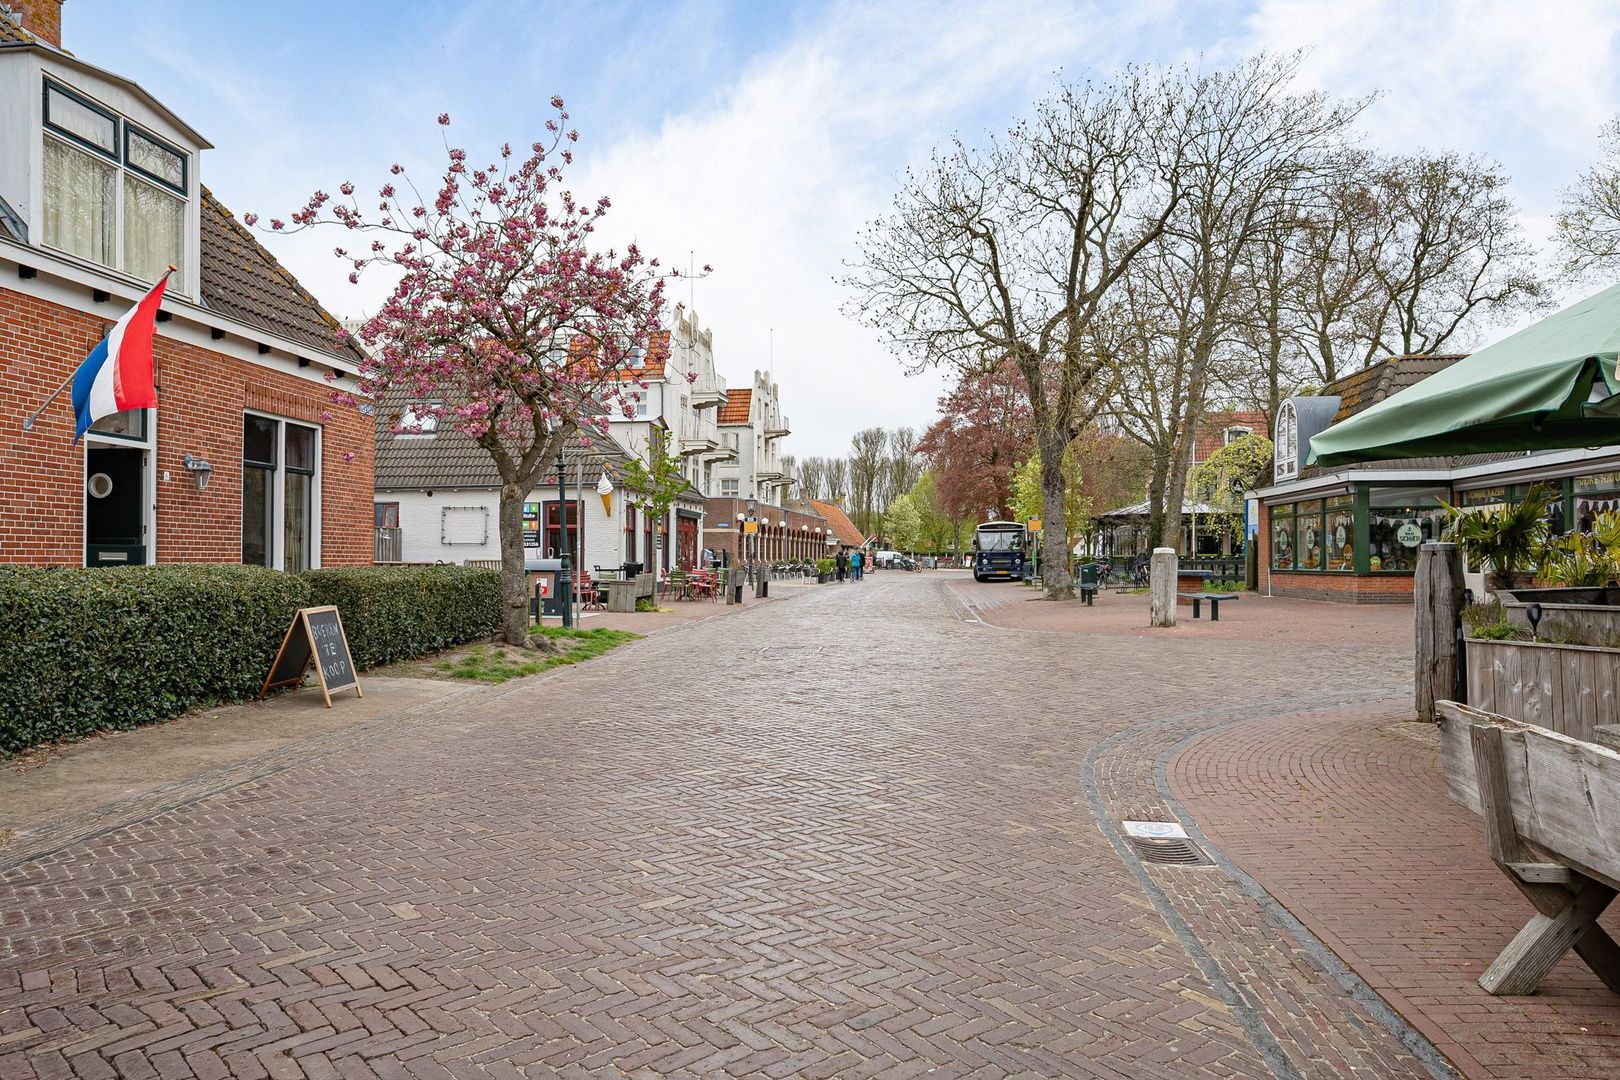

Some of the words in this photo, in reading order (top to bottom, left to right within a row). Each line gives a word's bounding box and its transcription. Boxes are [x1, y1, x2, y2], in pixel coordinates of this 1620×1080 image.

[311, 623, 339, 640] BOEKEN
[323, 642, 337, 656] TE
[322, 660, 346, 680] KOOP
